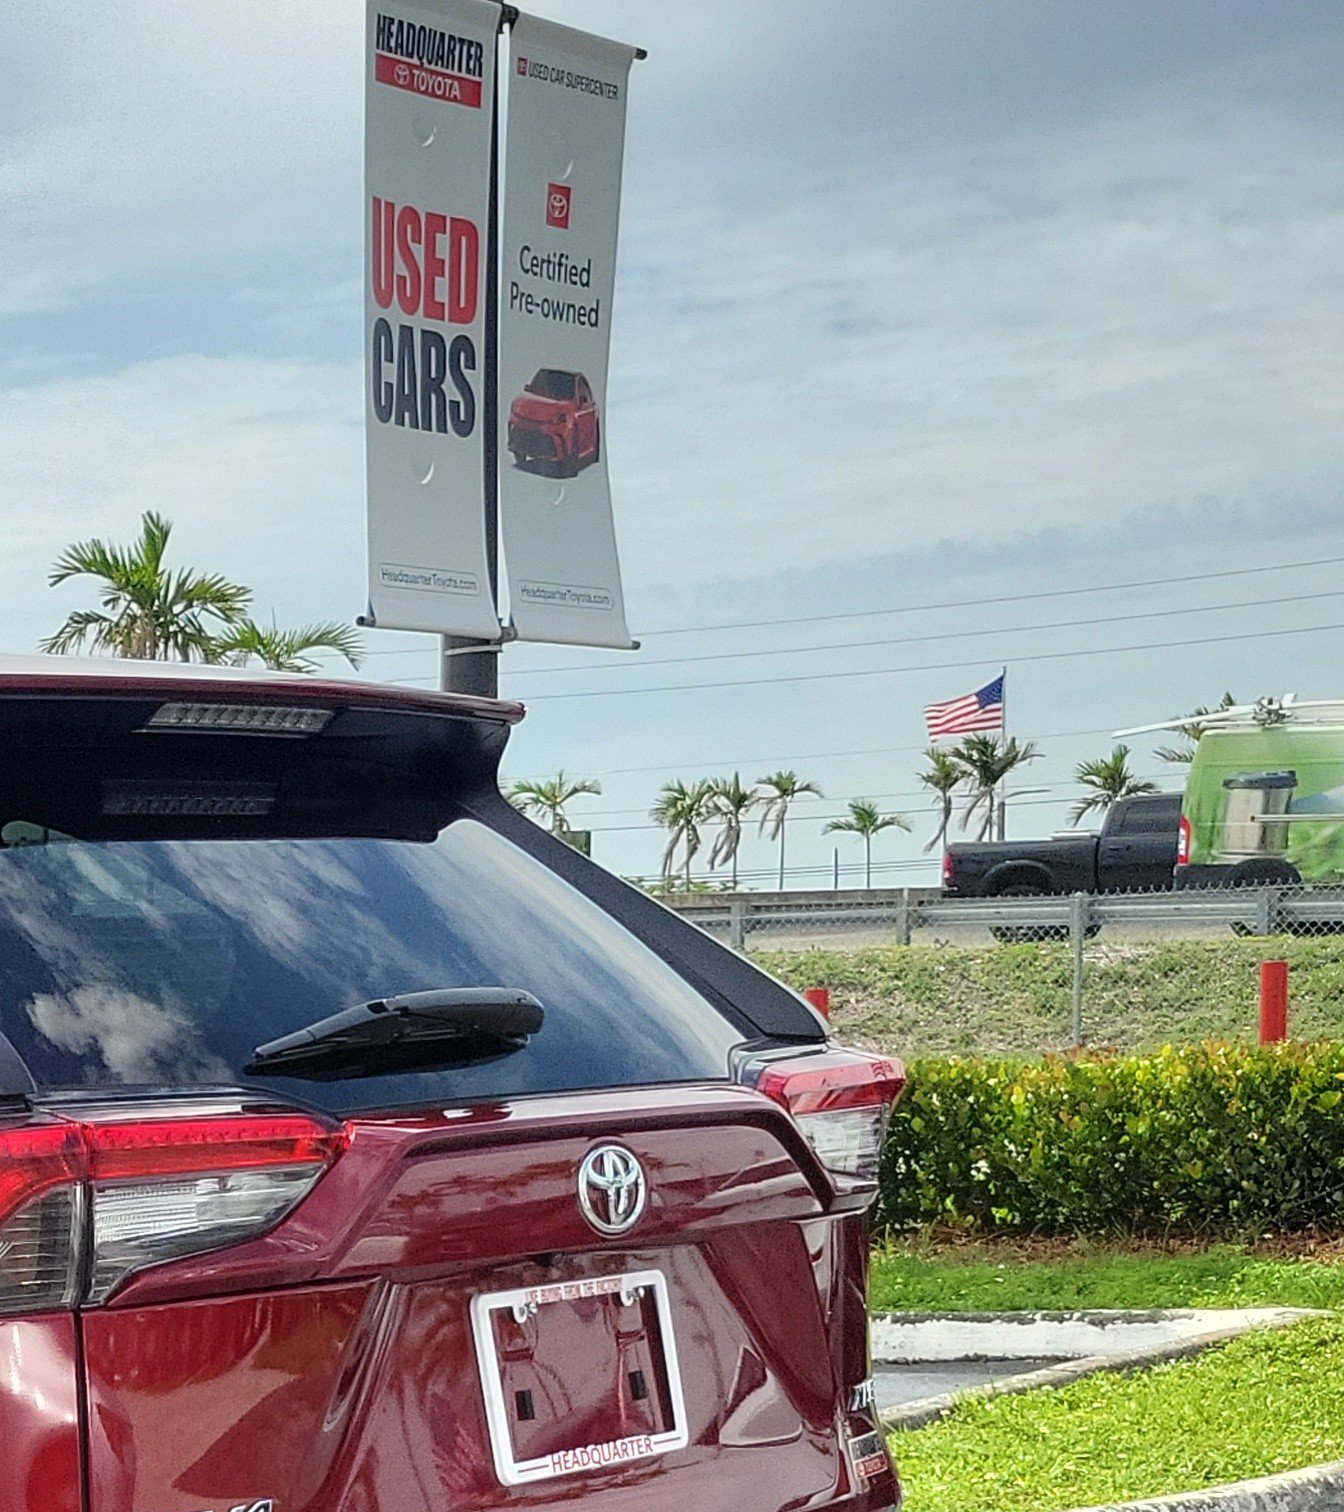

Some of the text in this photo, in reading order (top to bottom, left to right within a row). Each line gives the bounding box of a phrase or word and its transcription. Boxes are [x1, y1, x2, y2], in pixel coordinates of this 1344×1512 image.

[376, 13, 483, 78] HEADQUARTER
[412, 69, 461, 100] TOYOTA
[528, 61, 618, 100] USED CAR SUPERCENTER
[372, 195, 479, 325] USED
[519, 245, 591, 288] Certified
[510, 281, 599, 328] Pre-owned
[373, 317, 476, 438] CARS
[551, 1437, 654, 1473] HEADQUARTER
